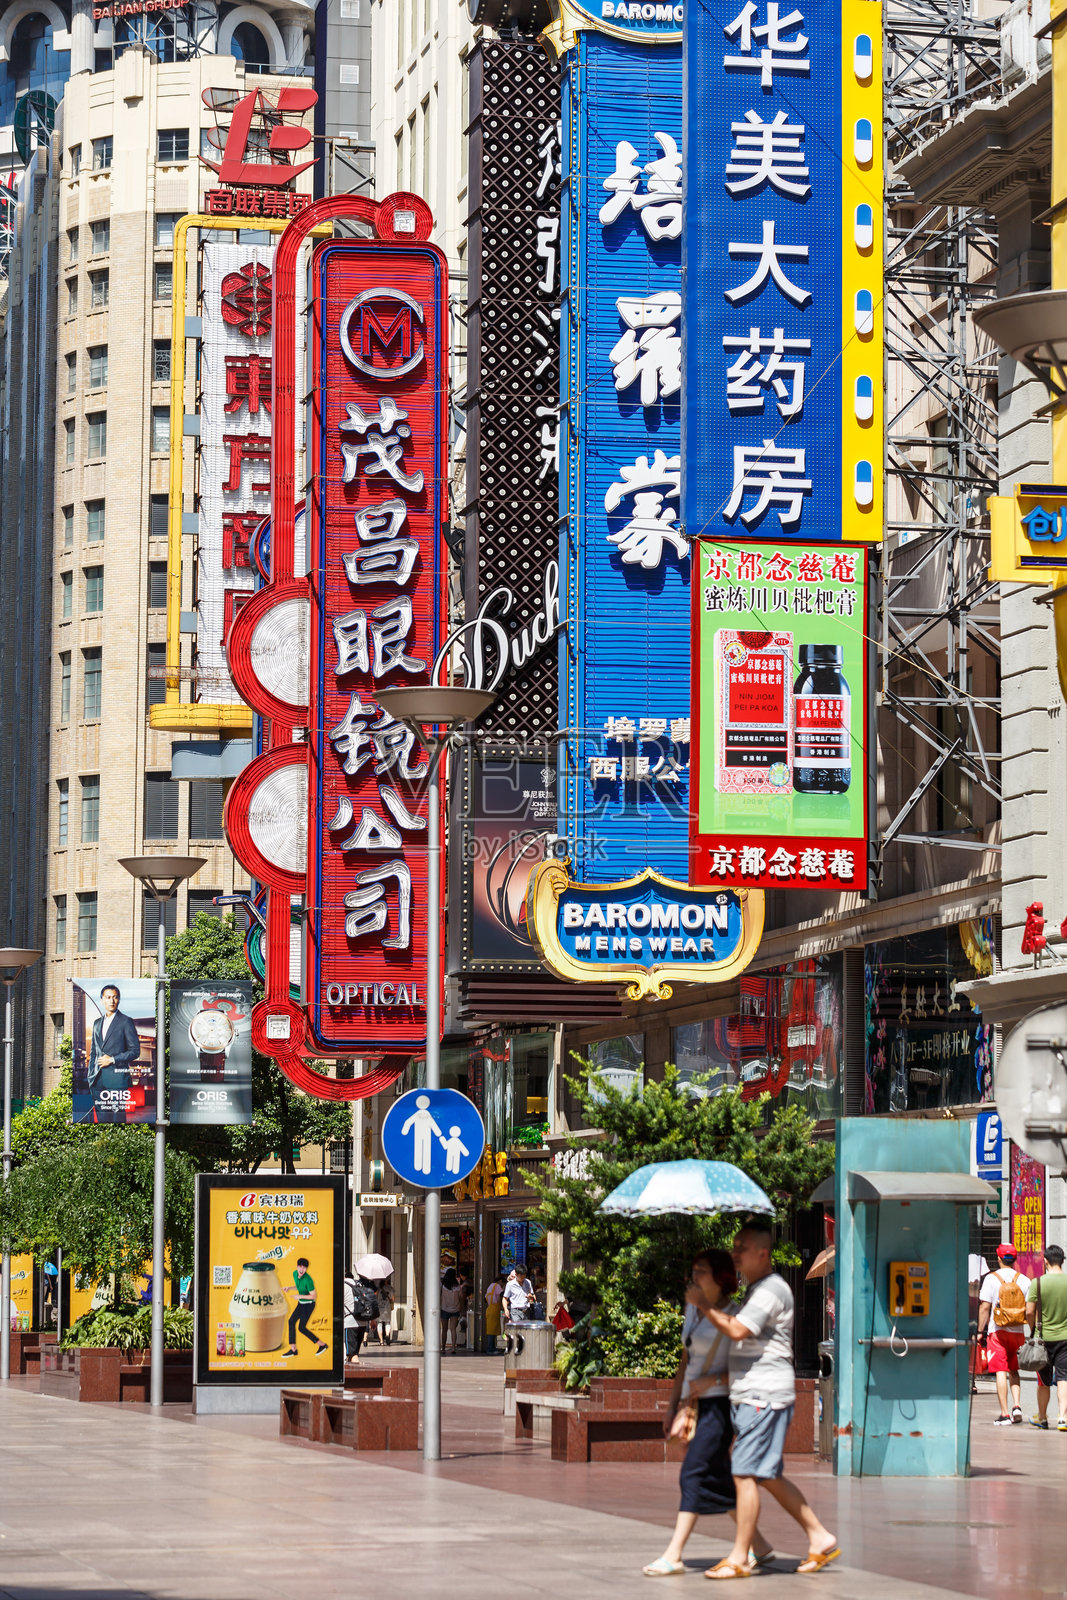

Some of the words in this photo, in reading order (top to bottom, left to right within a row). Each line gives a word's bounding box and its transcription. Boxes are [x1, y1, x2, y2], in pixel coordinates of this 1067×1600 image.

[92, 2, 142, 20] BAILIAN
[205, 189, 313, 217] 百联集团
[722, 2, 812, 525] 华美大药房
[704, 550, 855, 583] 京都念慈菴
[705, 586, 857, 616] 蜜炼川贝枇杷膏
[328, 396, 428, 949] 茂昌眼镜公司
[588, 756, 690, 783] 西服公
[709, 845, 855, 879] 京都念慈菴
[563, 903, 729, 930] BAROMON
[575, 936, 643, 952] MENS
[648, 936, 715, 953] WEAR
[326, 982, 424, 1005] OPTICAL
[100, 1090, 131, 1101] ORIS
[197, 1091, 228, 1101] ORIS
[259, 1193, 305, 1208] 宾格瑞
[1024, 1196, 1042, 1213] OPEN
[226, 1211, 319, 1225] 香蕉味牛奶饮料
